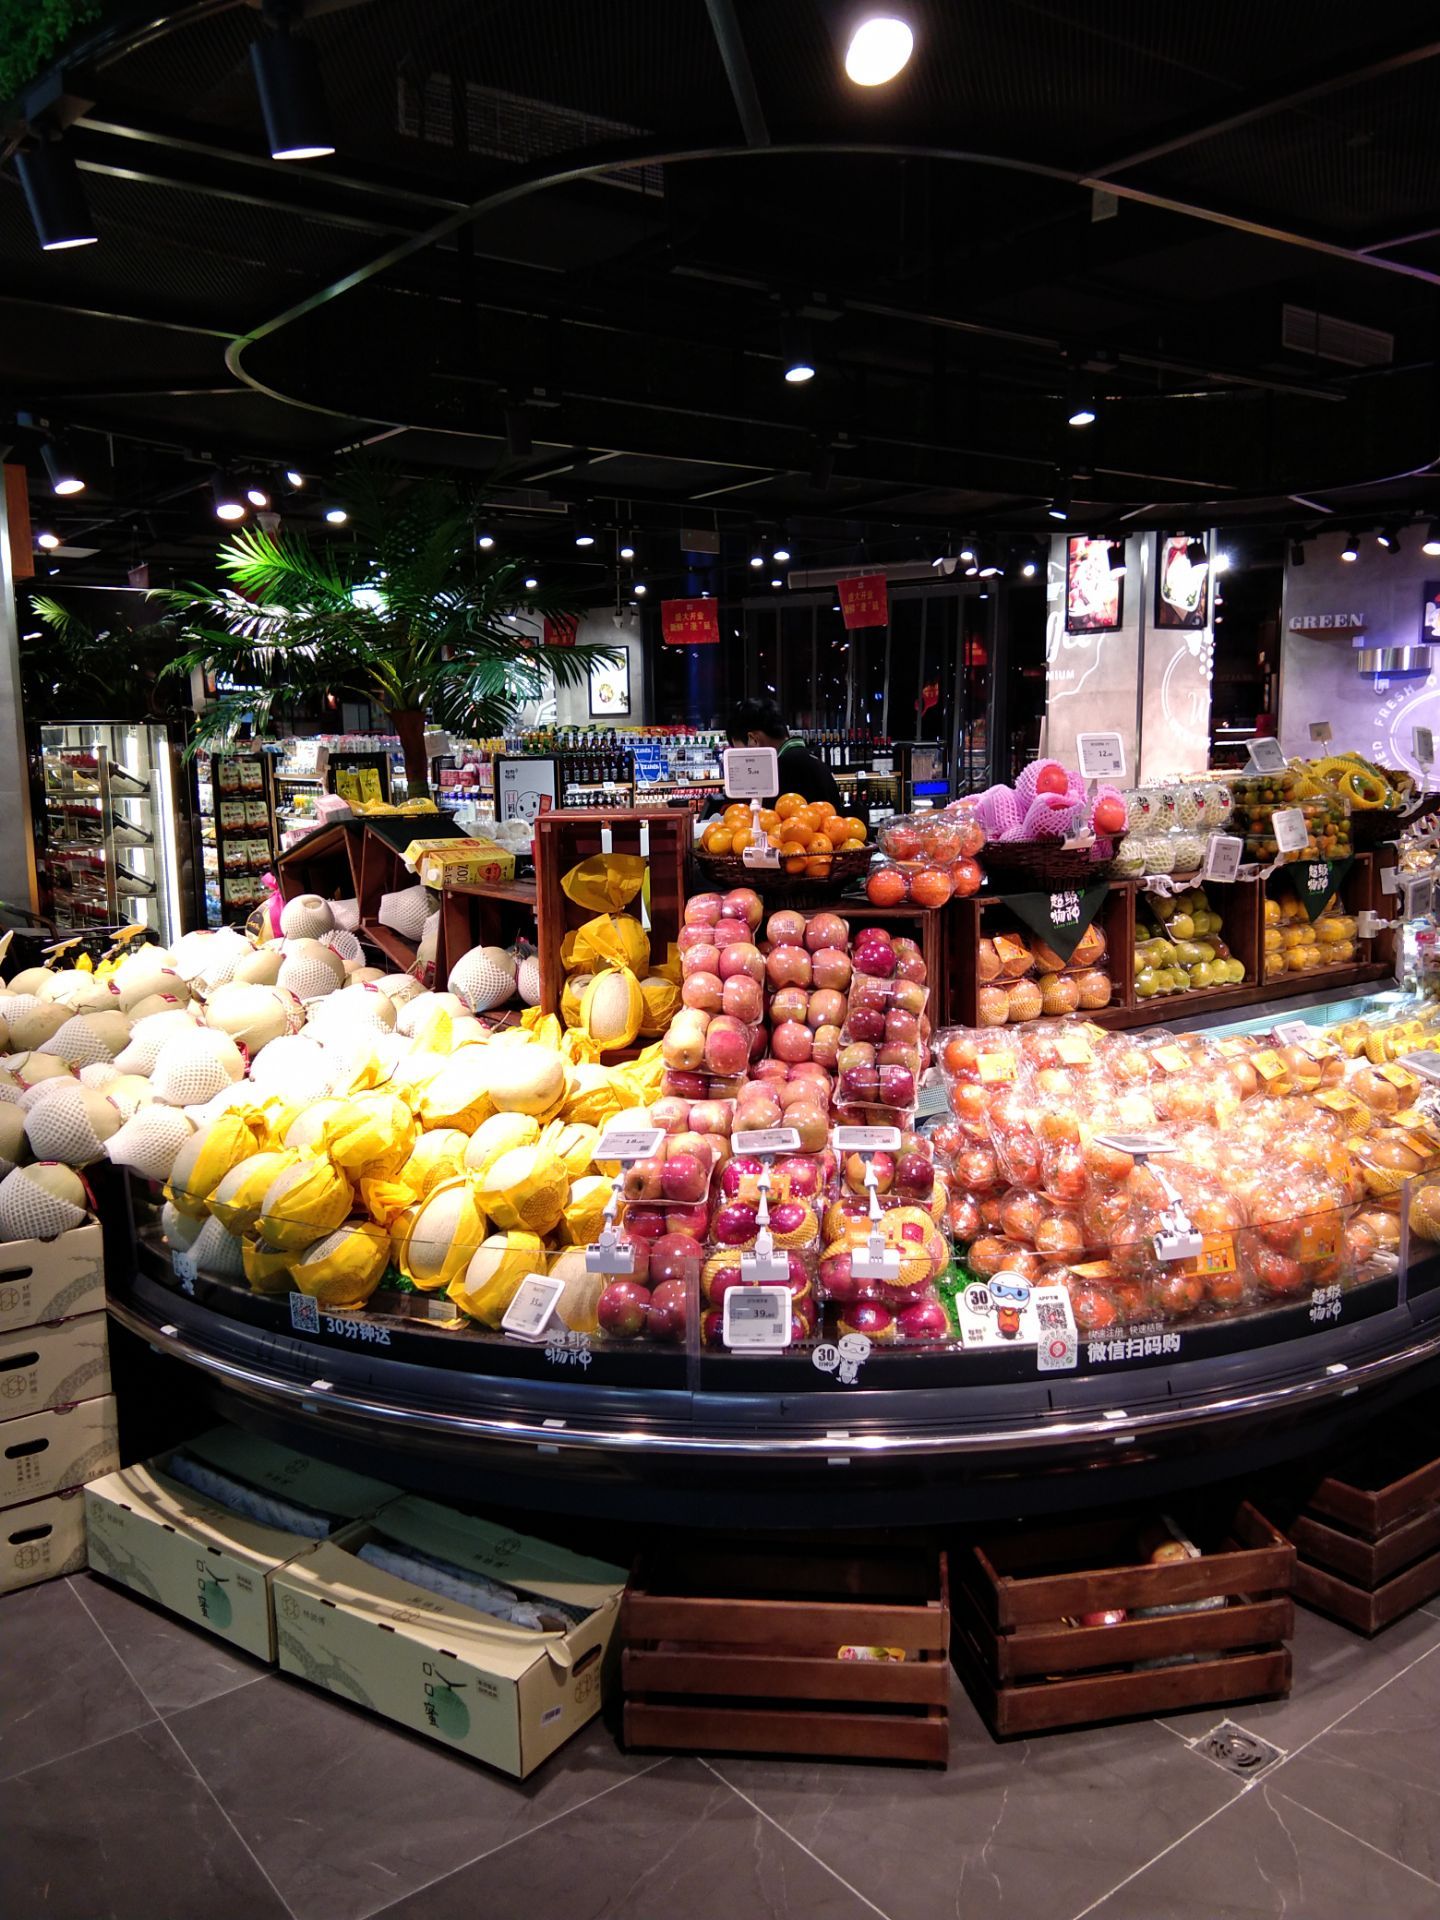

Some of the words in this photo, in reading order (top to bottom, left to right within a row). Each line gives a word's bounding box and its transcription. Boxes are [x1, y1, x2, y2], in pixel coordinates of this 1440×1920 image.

[1289, 613, 1364, 630] GREEN
[1374, 684, 1416, 727] FRESH
[1050, 891, 1080, 909] 超级
[1050, 904, 1080, 925] 物种
[970, 1290, 988, 1305] 30
[326, 1318, 391, 1345] 30分钟达
[818, 1348, 835, 1362] 30
[1087, 1333, 1181, 1363] 微信扫码购
[545, 1347, 592, 1371] 物种
